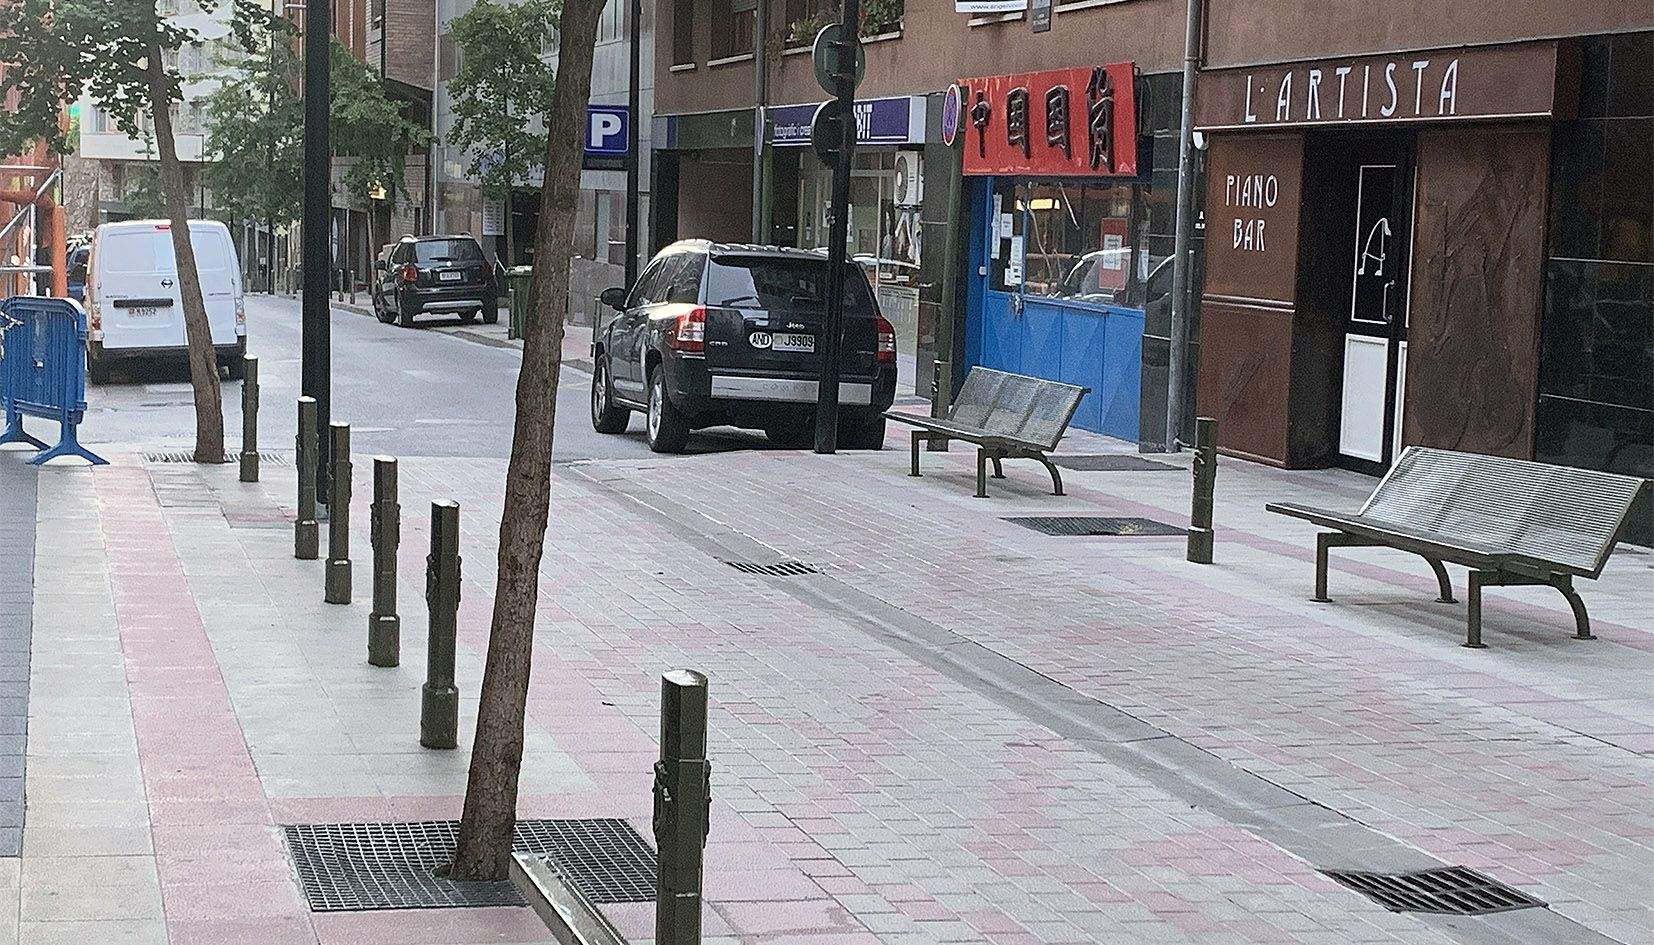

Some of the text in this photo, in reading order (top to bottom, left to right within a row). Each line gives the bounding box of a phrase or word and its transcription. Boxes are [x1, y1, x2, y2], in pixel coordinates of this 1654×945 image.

[591, 113, 622, 147] P
[1226, 174, 1279, 208] PIANO
[1233, 218, 1265, 251] BAR
[786, 321, 805, 330] Jeep
[752, 334, 770, 346] AND
[784, 335, 814, 347] J9909
